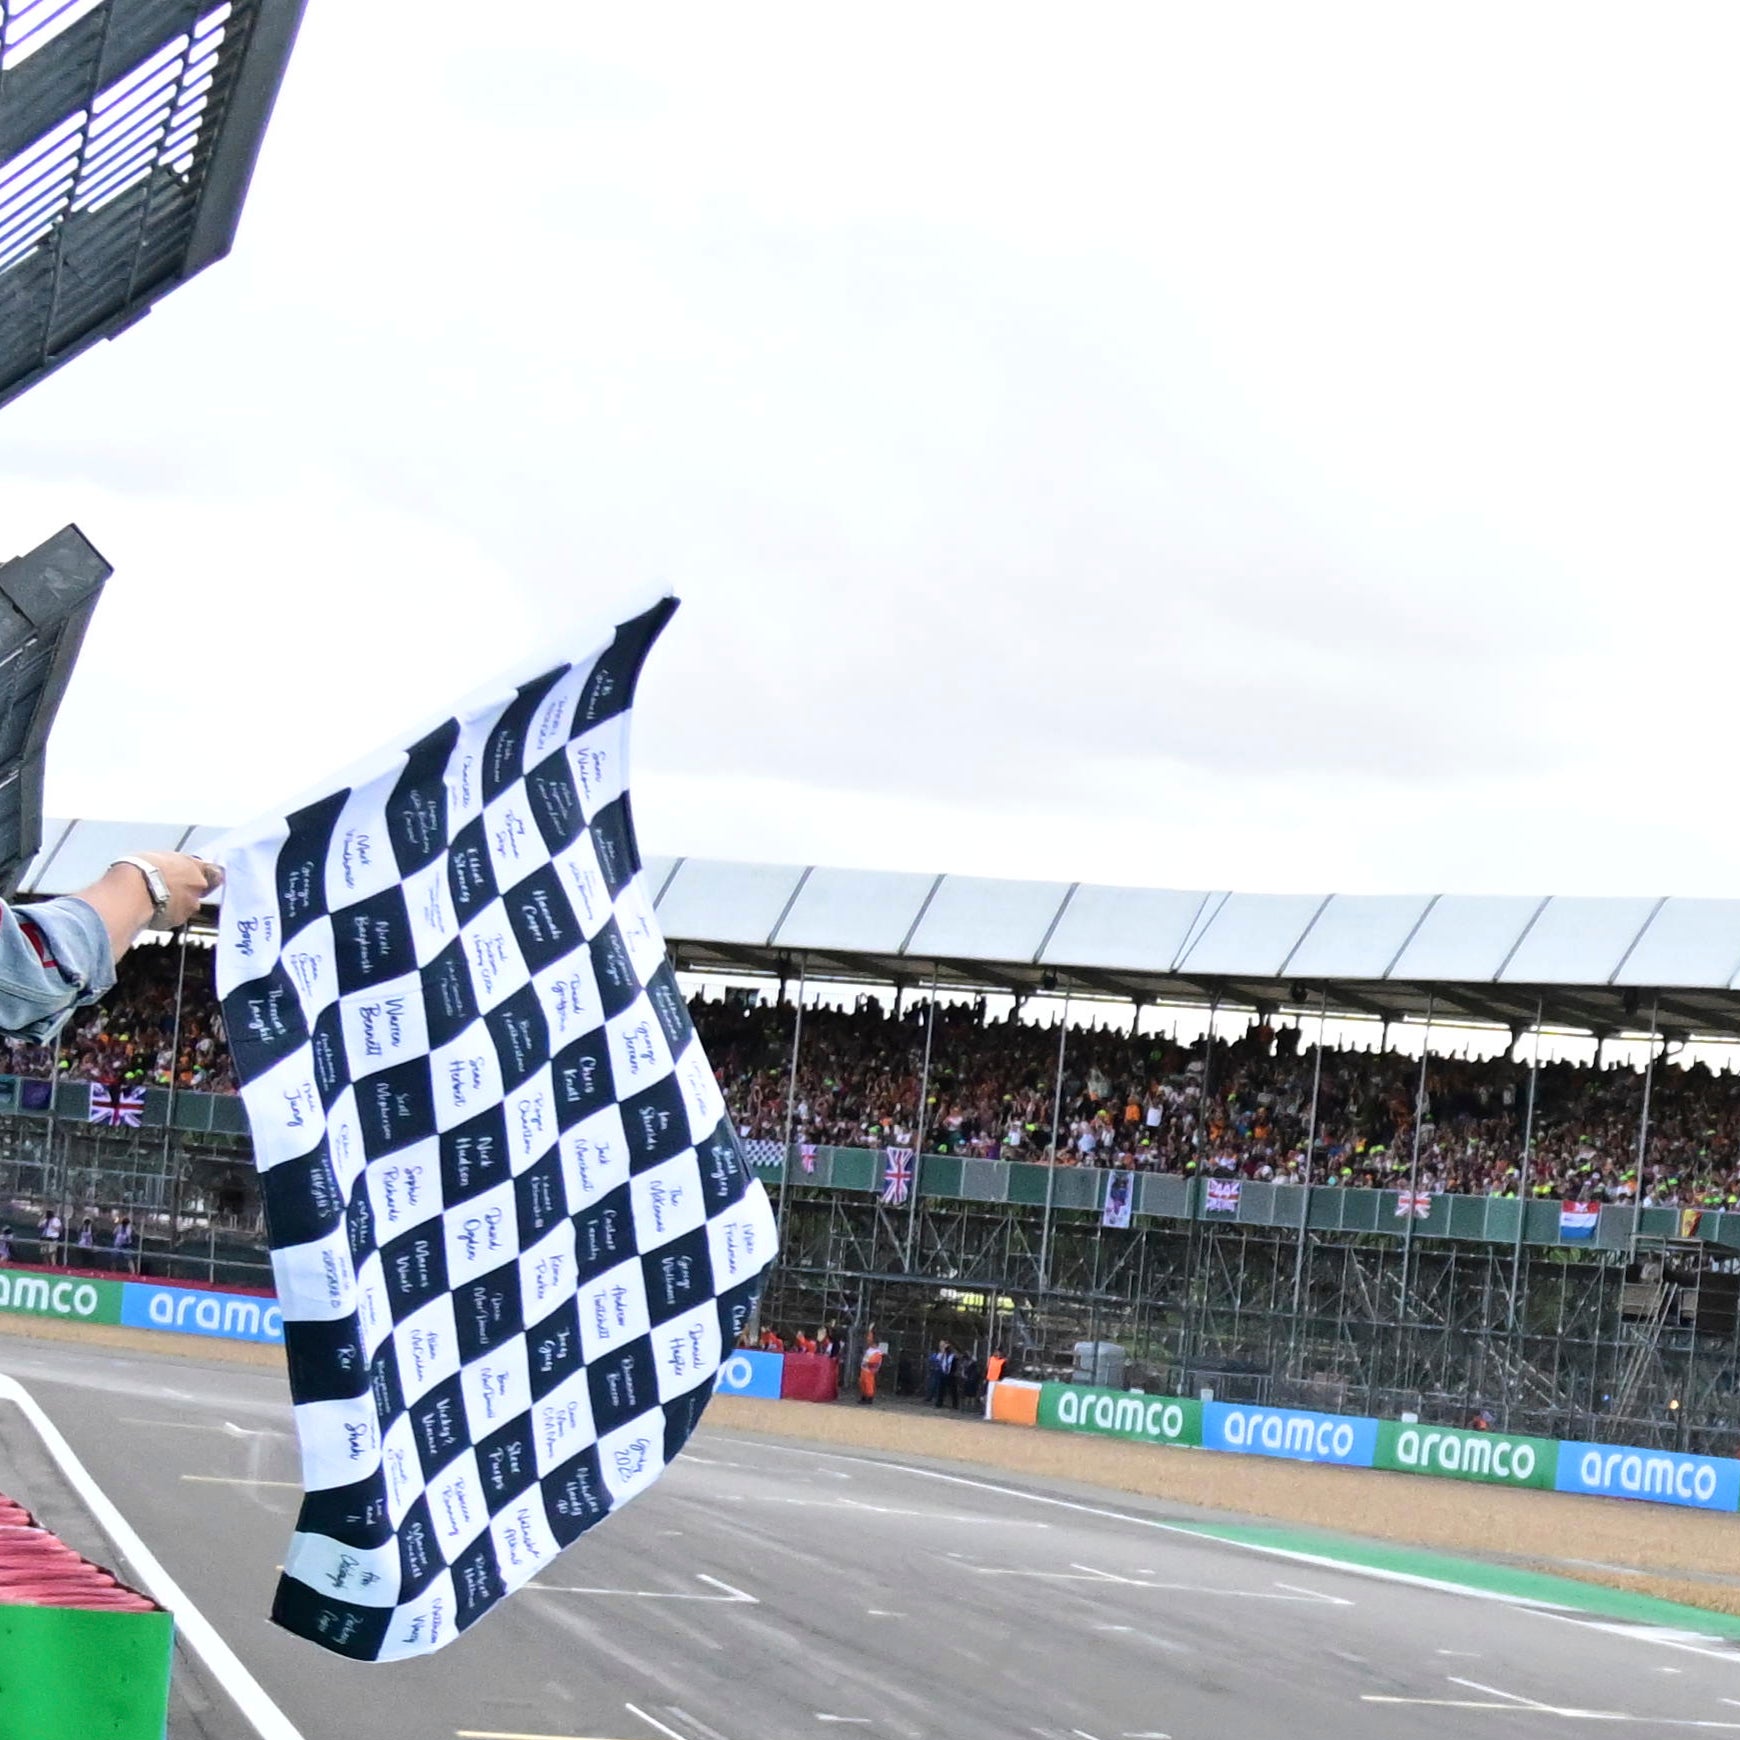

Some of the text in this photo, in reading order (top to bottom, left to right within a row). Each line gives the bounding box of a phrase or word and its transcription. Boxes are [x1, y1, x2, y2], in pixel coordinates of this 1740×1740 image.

[531, 889, 562, 941] Hannah
[384, 997, 403, 1049] Warren
[454, 1136, 473, 1187] Hudson
[476, 1136, 494, 1169] Nick
[456, 1218, 481, 1262] Ogden
[483, 1206, 503, 1252] David
[149, 1292, 283, 1337] aramc
[1058, 1392, 1183, 1437] aramco
[1224, 1412, 1354, 1456] aramco
[1397, 1430, 1536, 1480] aramco
[1581, 1451, 1716, 1500] aramco
